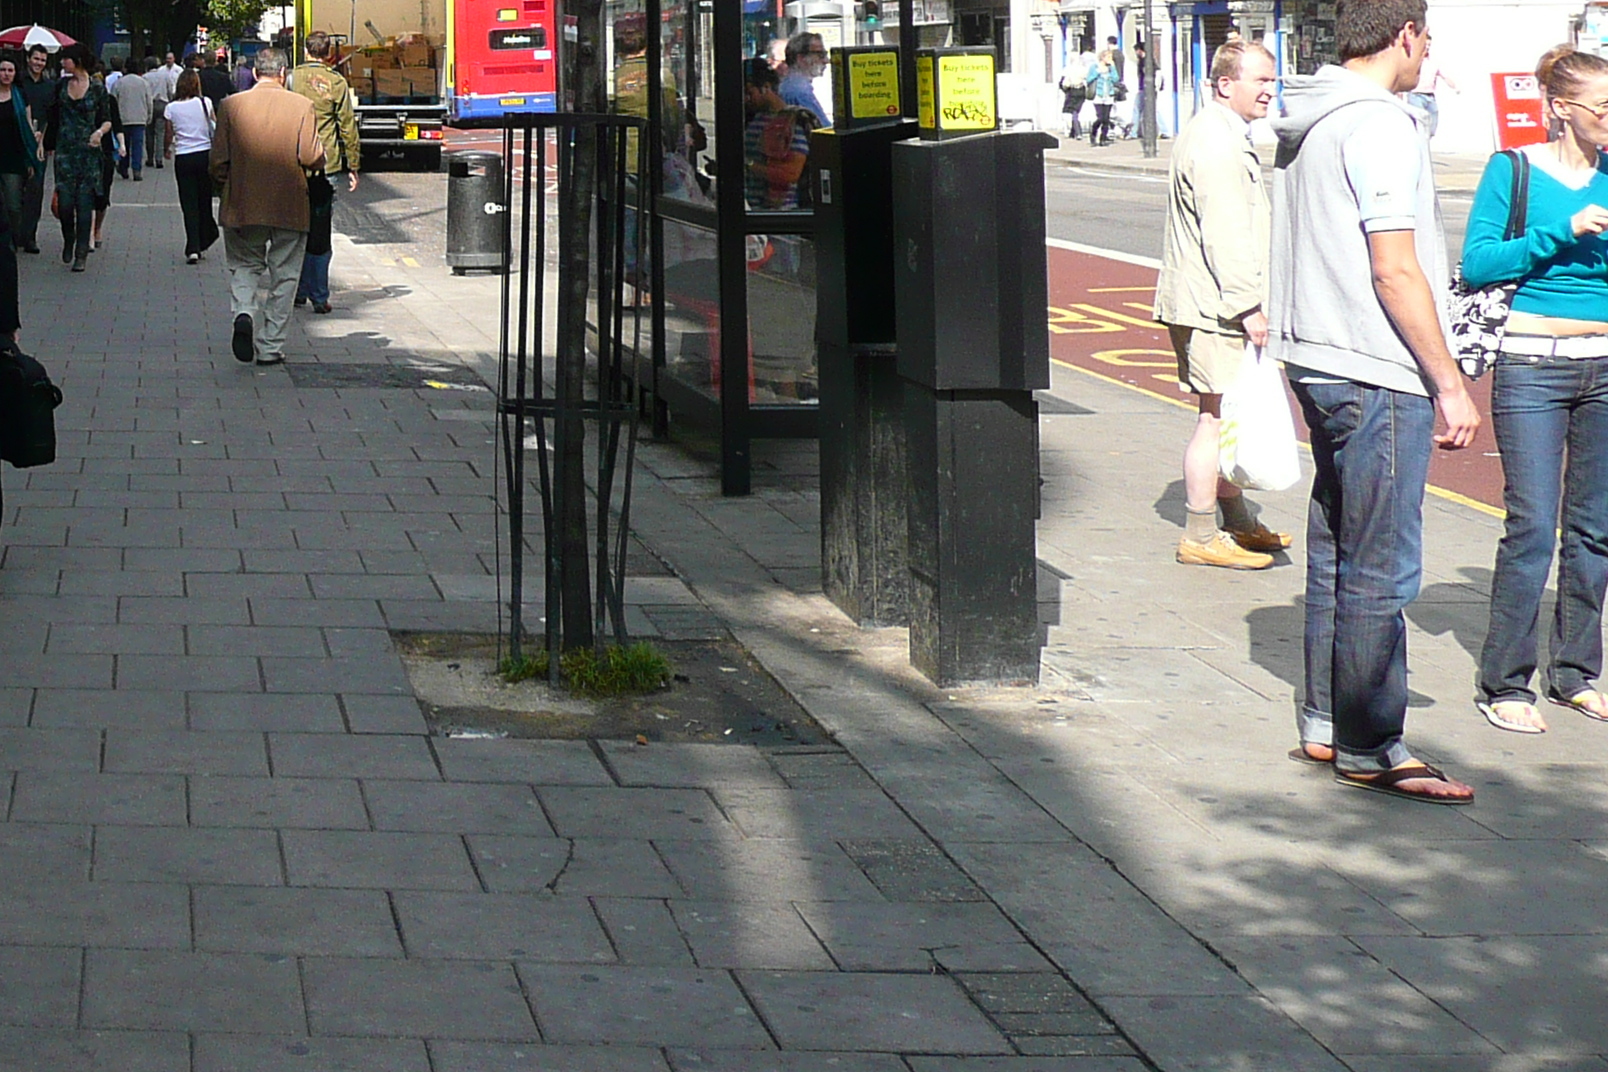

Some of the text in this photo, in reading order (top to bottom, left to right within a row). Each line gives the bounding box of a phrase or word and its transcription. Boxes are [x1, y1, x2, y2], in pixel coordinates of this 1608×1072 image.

[852, 59, 894, 68] Buy tickets
[943, 64, 989, 73] Buy tickets
[858, 91, 892, 99] boarding
